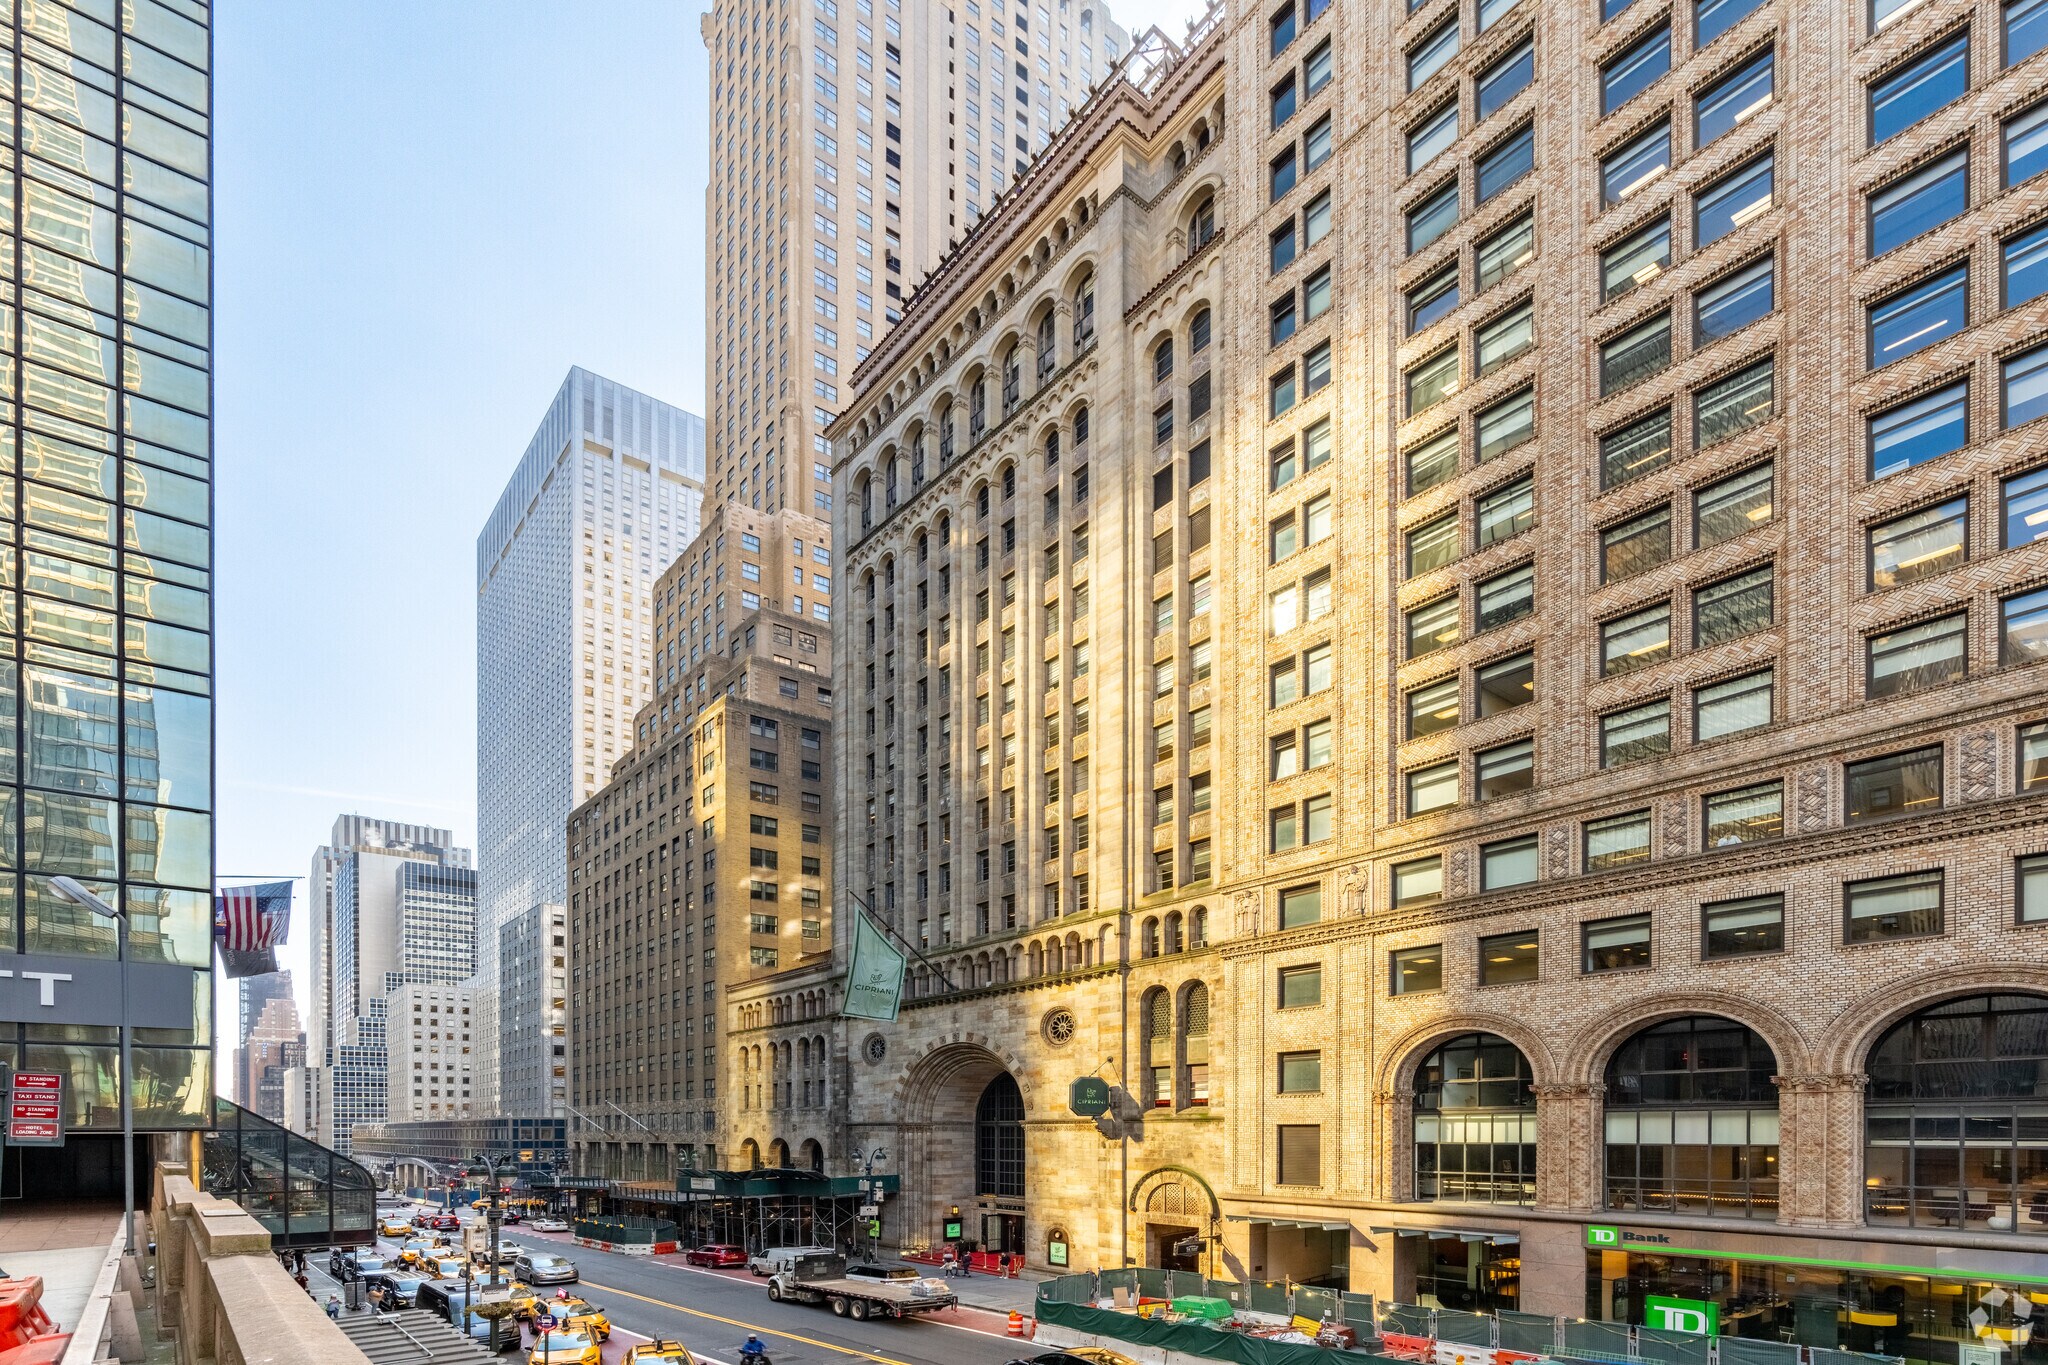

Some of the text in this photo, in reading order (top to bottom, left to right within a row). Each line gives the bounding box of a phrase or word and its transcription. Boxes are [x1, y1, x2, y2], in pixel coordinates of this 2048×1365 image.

[854, 984, 894, 995] CIPRIANI
[1590, 1229, 1670, 1244] TD Bank
[1653, 1305, 1709, 1335] TD
